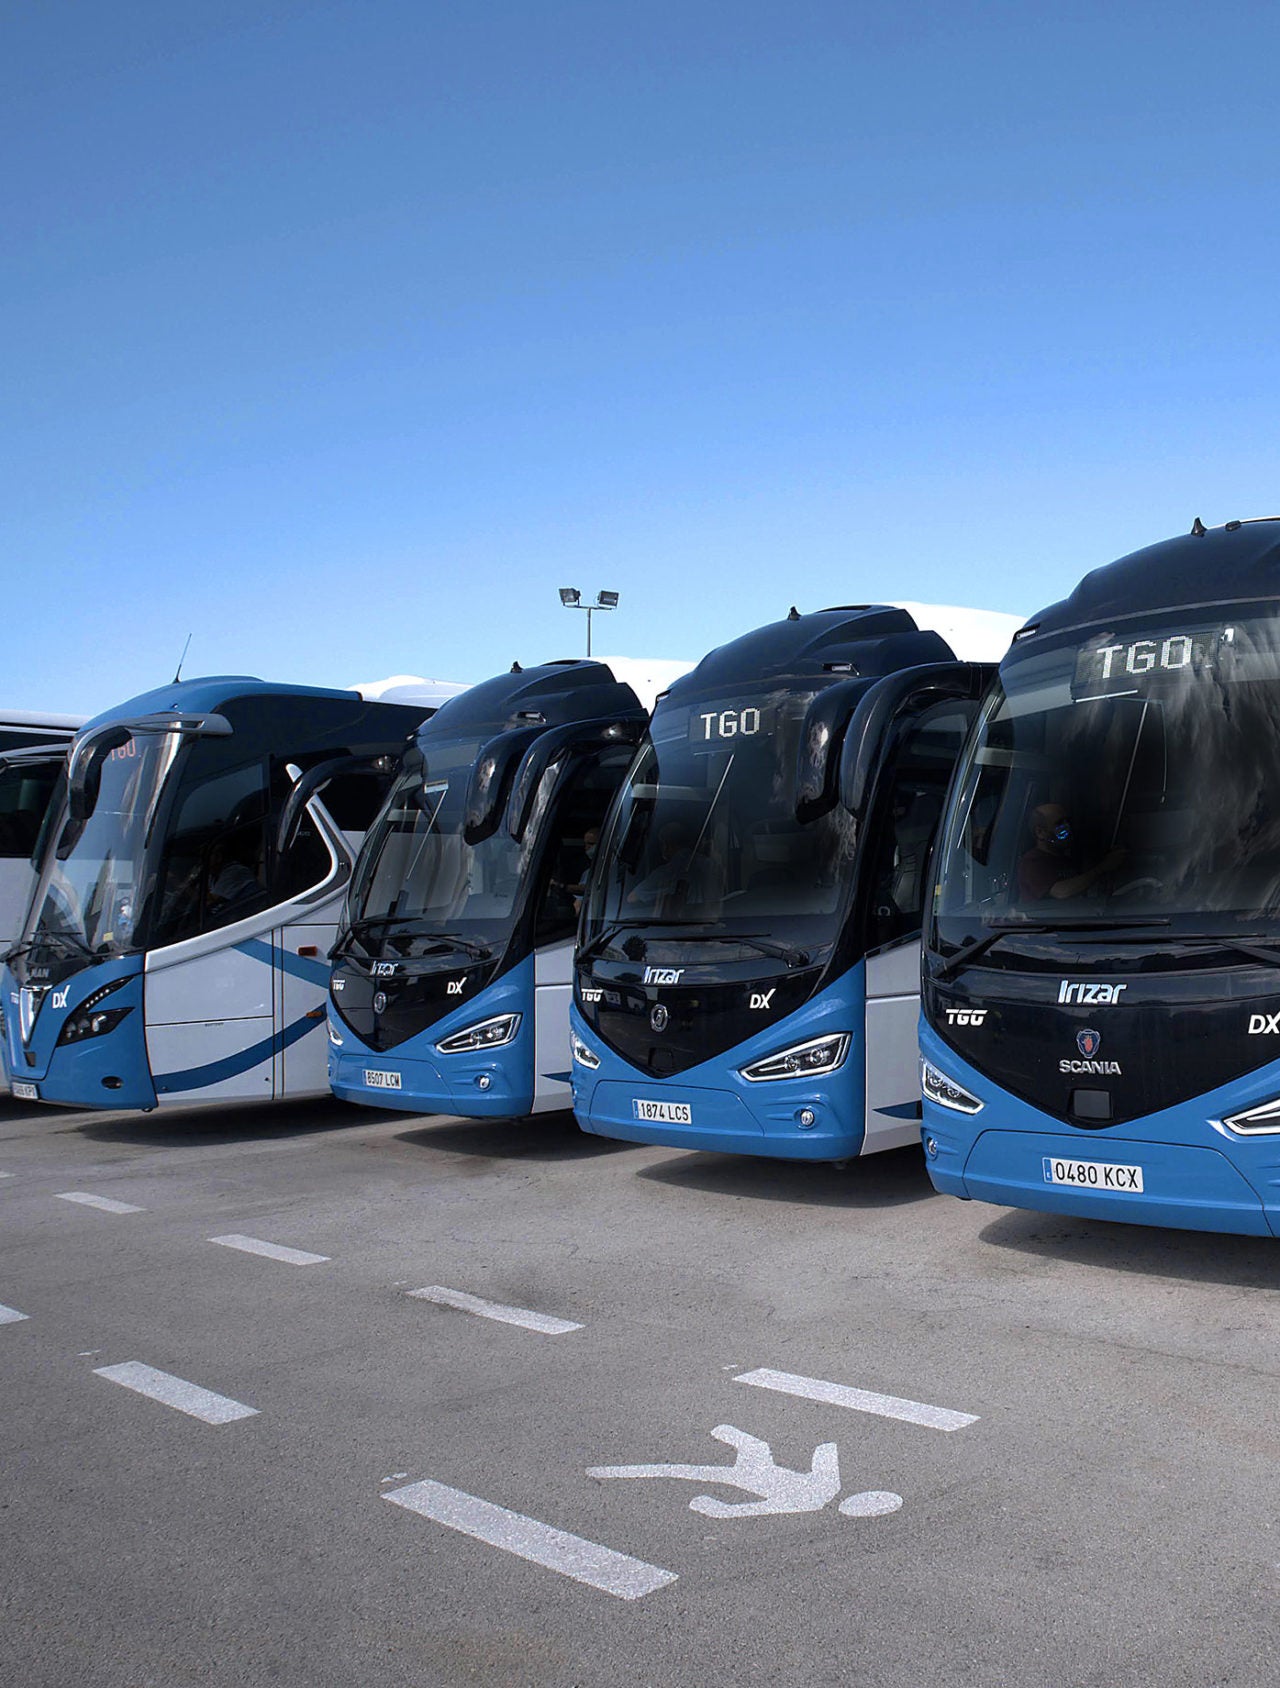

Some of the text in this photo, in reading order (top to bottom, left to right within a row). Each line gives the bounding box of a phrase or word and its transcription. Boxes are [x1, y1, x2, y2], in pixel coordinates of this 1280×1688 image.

[1096, 635, 1193, 679] TGO
[700, 707, 760, 740] TGO
[643, 966, 685, 985] Irizar
[446, 977, 467, 995] DX
[580, 988, 604, 1002] TGO
[1057, 980, 1128, 1005] Irizar
[52, 985, 70, 1009] DX
[749, 988, 777, 1009] DX
[945, 1008, 988, 1026] TGO
[1058, 1059, 1123, 1075] SCANIA
[641, 1102, 689, 1121] 1874 LCS
[1055, 1162, 1098, 1185] 0480
[1103, 1166, 1139, 1189] KCX
